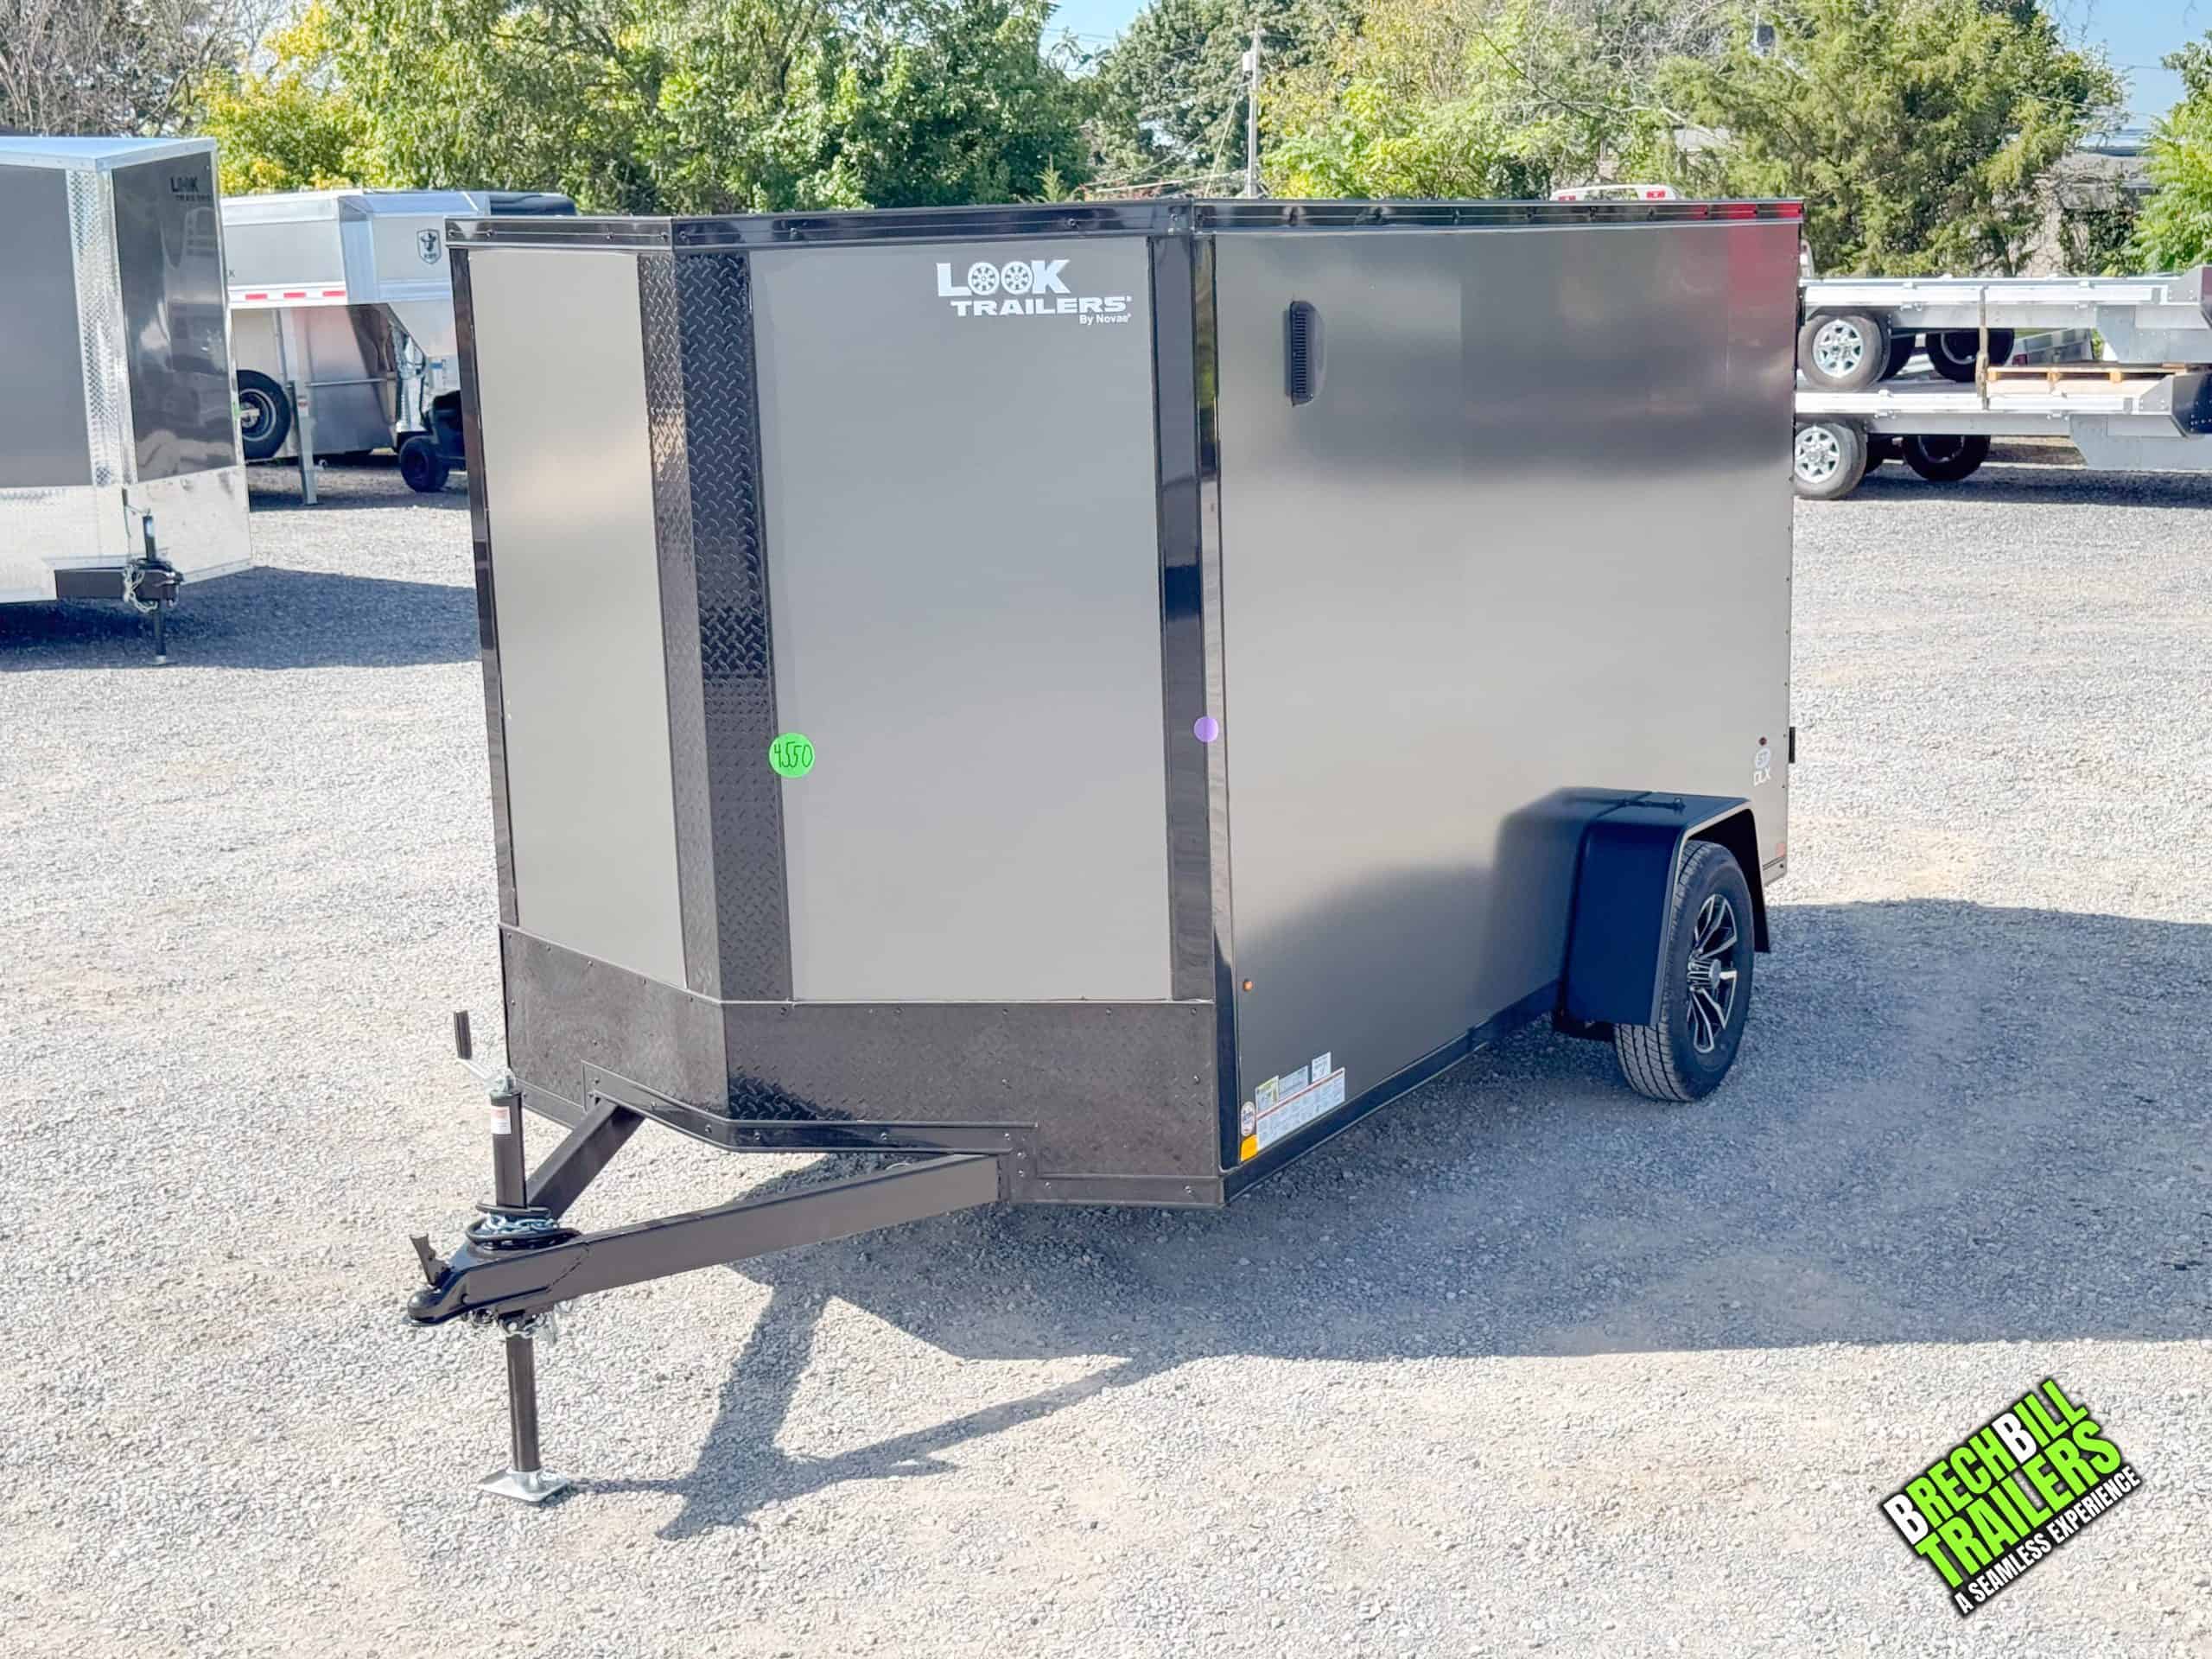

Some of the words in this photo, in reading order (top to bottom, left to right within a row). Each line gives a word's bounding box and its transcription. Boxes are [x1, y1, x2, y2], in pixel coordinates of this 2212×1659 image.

[936, 259, 1071, 297] LOOK
[950, 296, 1128, 317] TRAILERS
[1079, 315, 1094, 326] By
[773, 741, 813, 768] 4550
